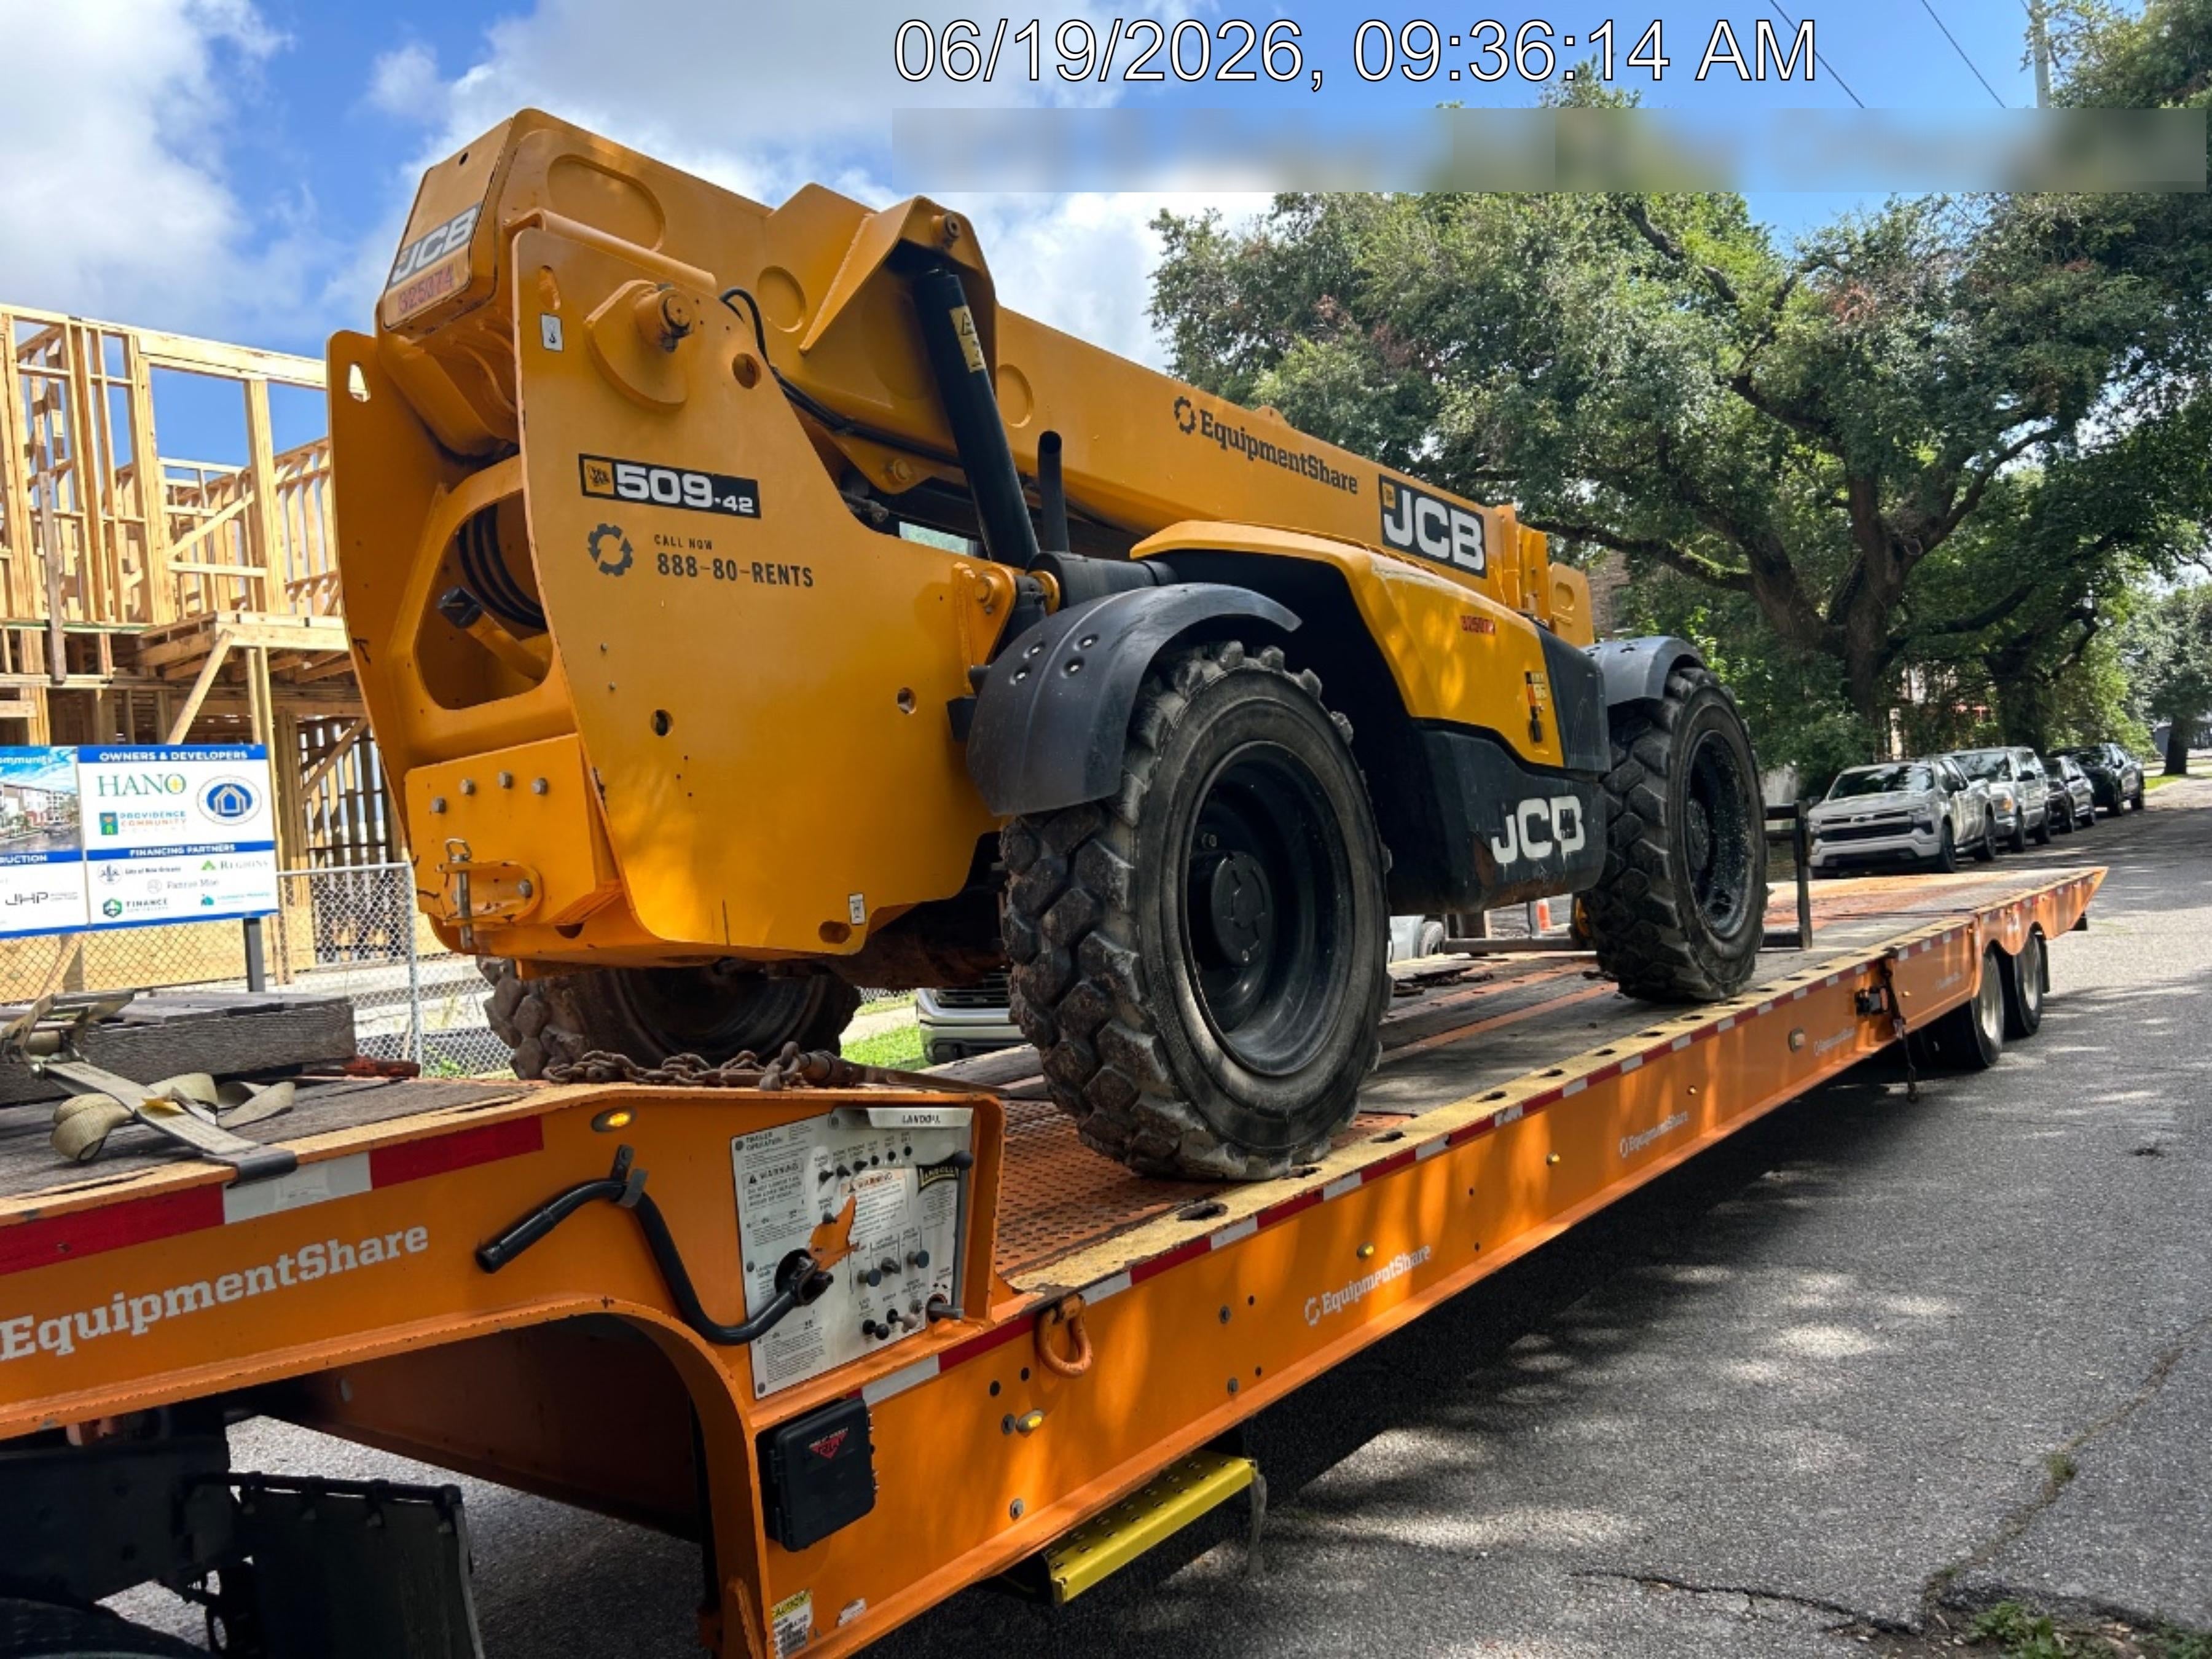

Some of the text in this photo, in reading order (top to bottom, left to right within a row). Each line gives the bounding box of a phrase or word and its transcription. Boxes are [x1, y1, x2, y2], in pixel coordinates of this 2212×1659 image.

[392, 208, 477, 282] JCB
[1200, 409, 1359, 494] EquipmentShare
[654, 534, 713, 550] CALL NOW
[1384, 490, 1484, 571] JCB
[657, 553, 814, 587] 888-80-RENTS
[99, 750, 248, 761] OWNERS & DEVELOPERS
[97, 773, 186, 797] HANO
[121, 818, 187, 827] COMMUNITY
[130, 844, 235, 857] FINANCING PARTNERS
[0, 1225, 428, 1362] EquipmentShare
[1322, 1245, 1432, 1315] EquipmentShare
